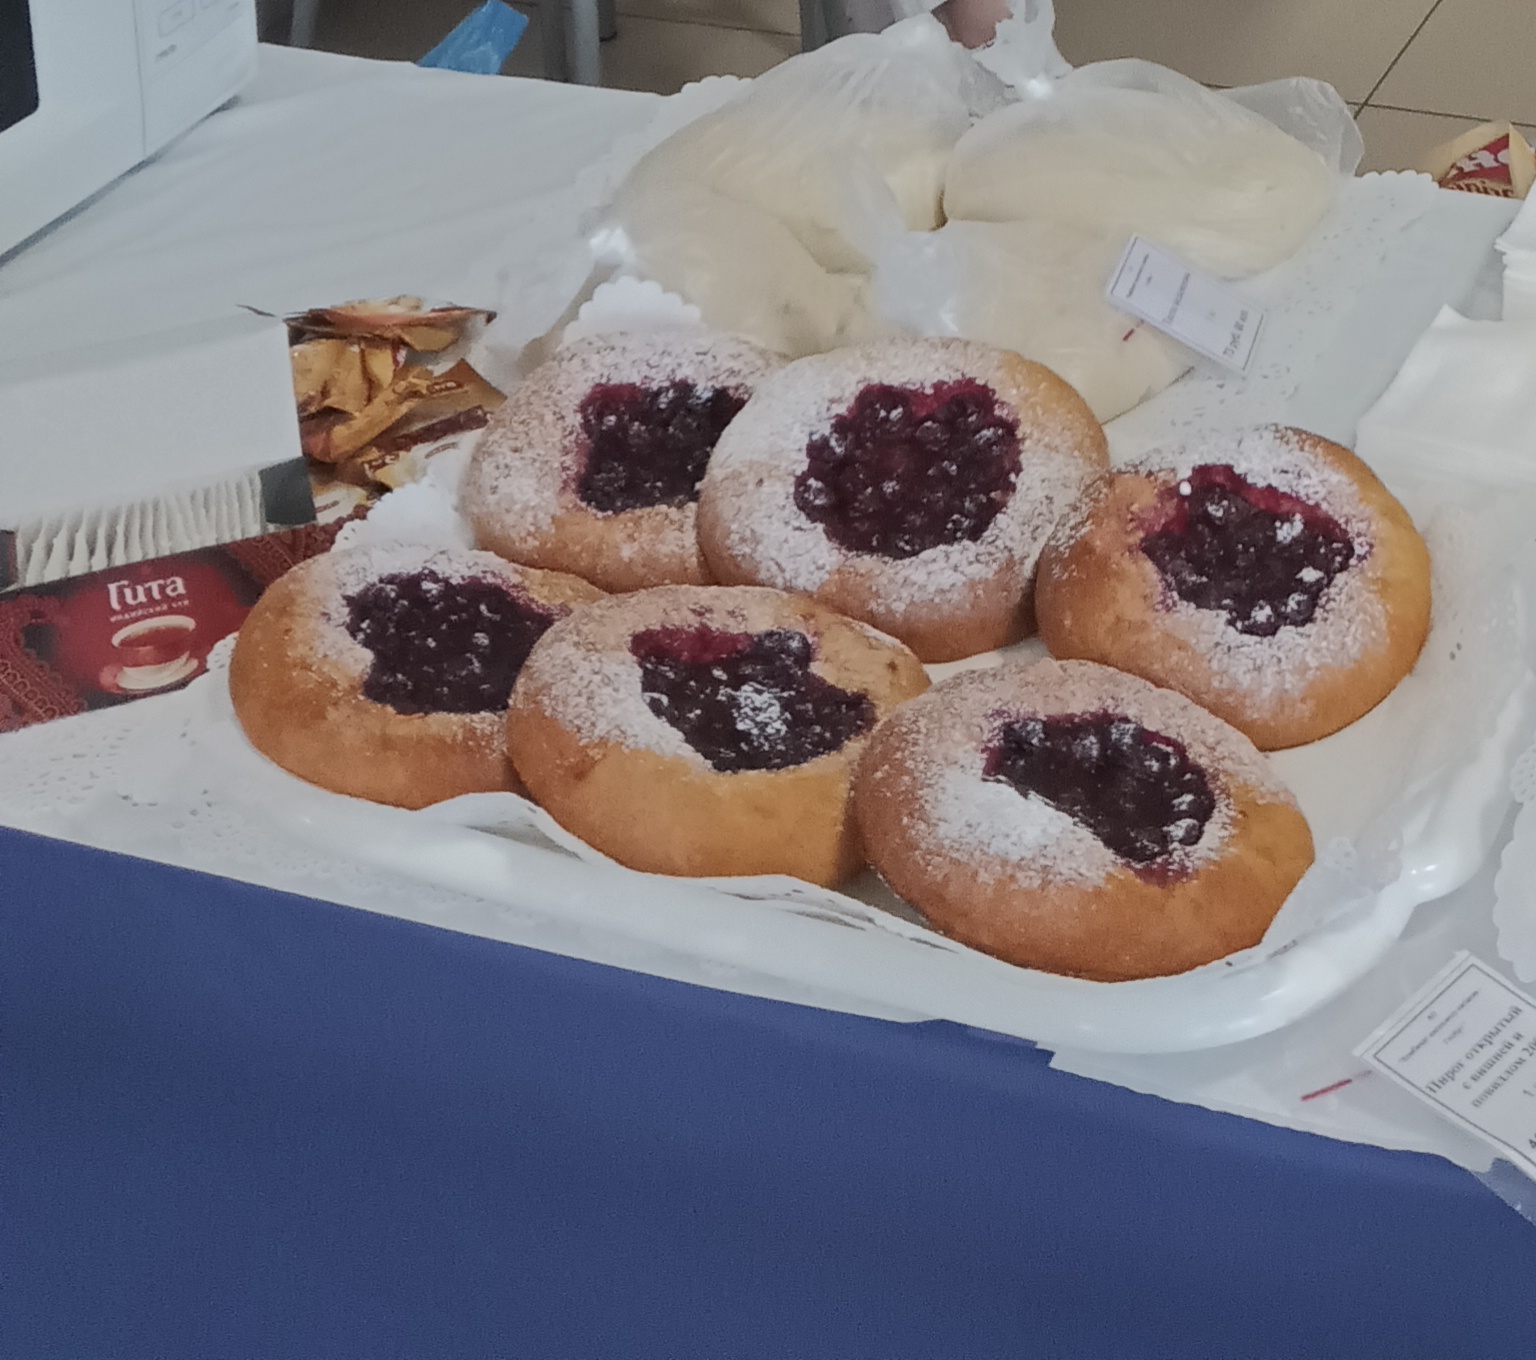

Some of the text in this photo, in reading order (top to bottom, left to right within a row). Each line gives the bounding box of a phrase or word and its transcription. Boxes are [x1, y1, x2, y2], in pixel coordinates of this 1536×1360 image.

[107, 576, 186, 611] Гита
[1425, 1062, 1464, 1094] Пирог
[1465, 1005, 1523, 1061] открытый
[1470, 1039, 1515, 1083] вишней
[1512, 1031, 1524, 1042] и
[1471, 1056, 1526, 1108] повидлом
